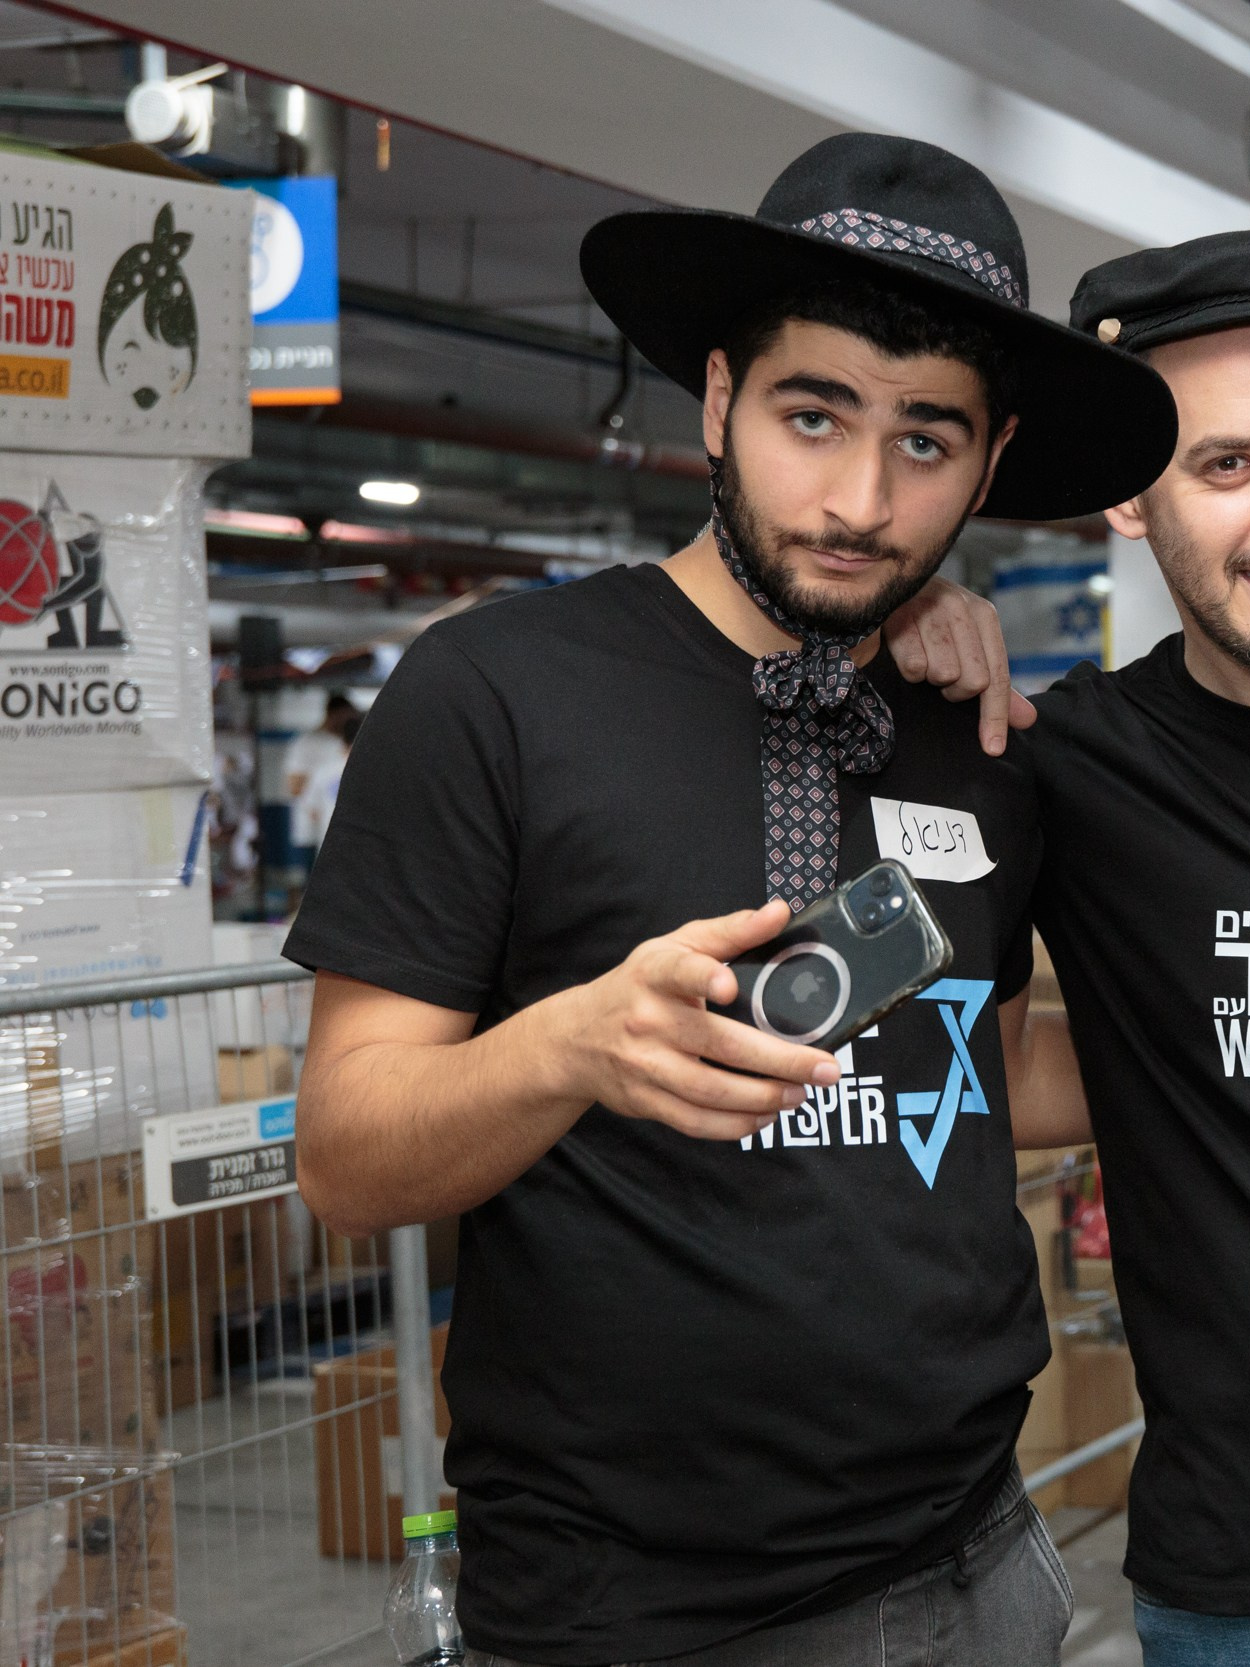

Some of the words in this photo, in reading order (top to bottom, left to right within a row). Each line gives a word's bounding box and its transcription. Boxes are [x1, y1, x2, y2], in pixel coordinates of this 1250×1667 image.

[13, 201, 73, 251] הגיע
[17, 253, 74, 291] עכשיו
[0, 294, 75, 348] משה
[0, 362, 64, 393] a.co.il
[0, 681, 141, 719] ONiGO
[26, 723, 91, 738] Worldwide
[96, 720, 142, 737] Moving
[899, 801, 967, 855] דניאל
[1213, 997, 1246, 1017] עם
[208, 1152, 256, 1181] זמנית
[257, 1146, 286, 1170] גדר
